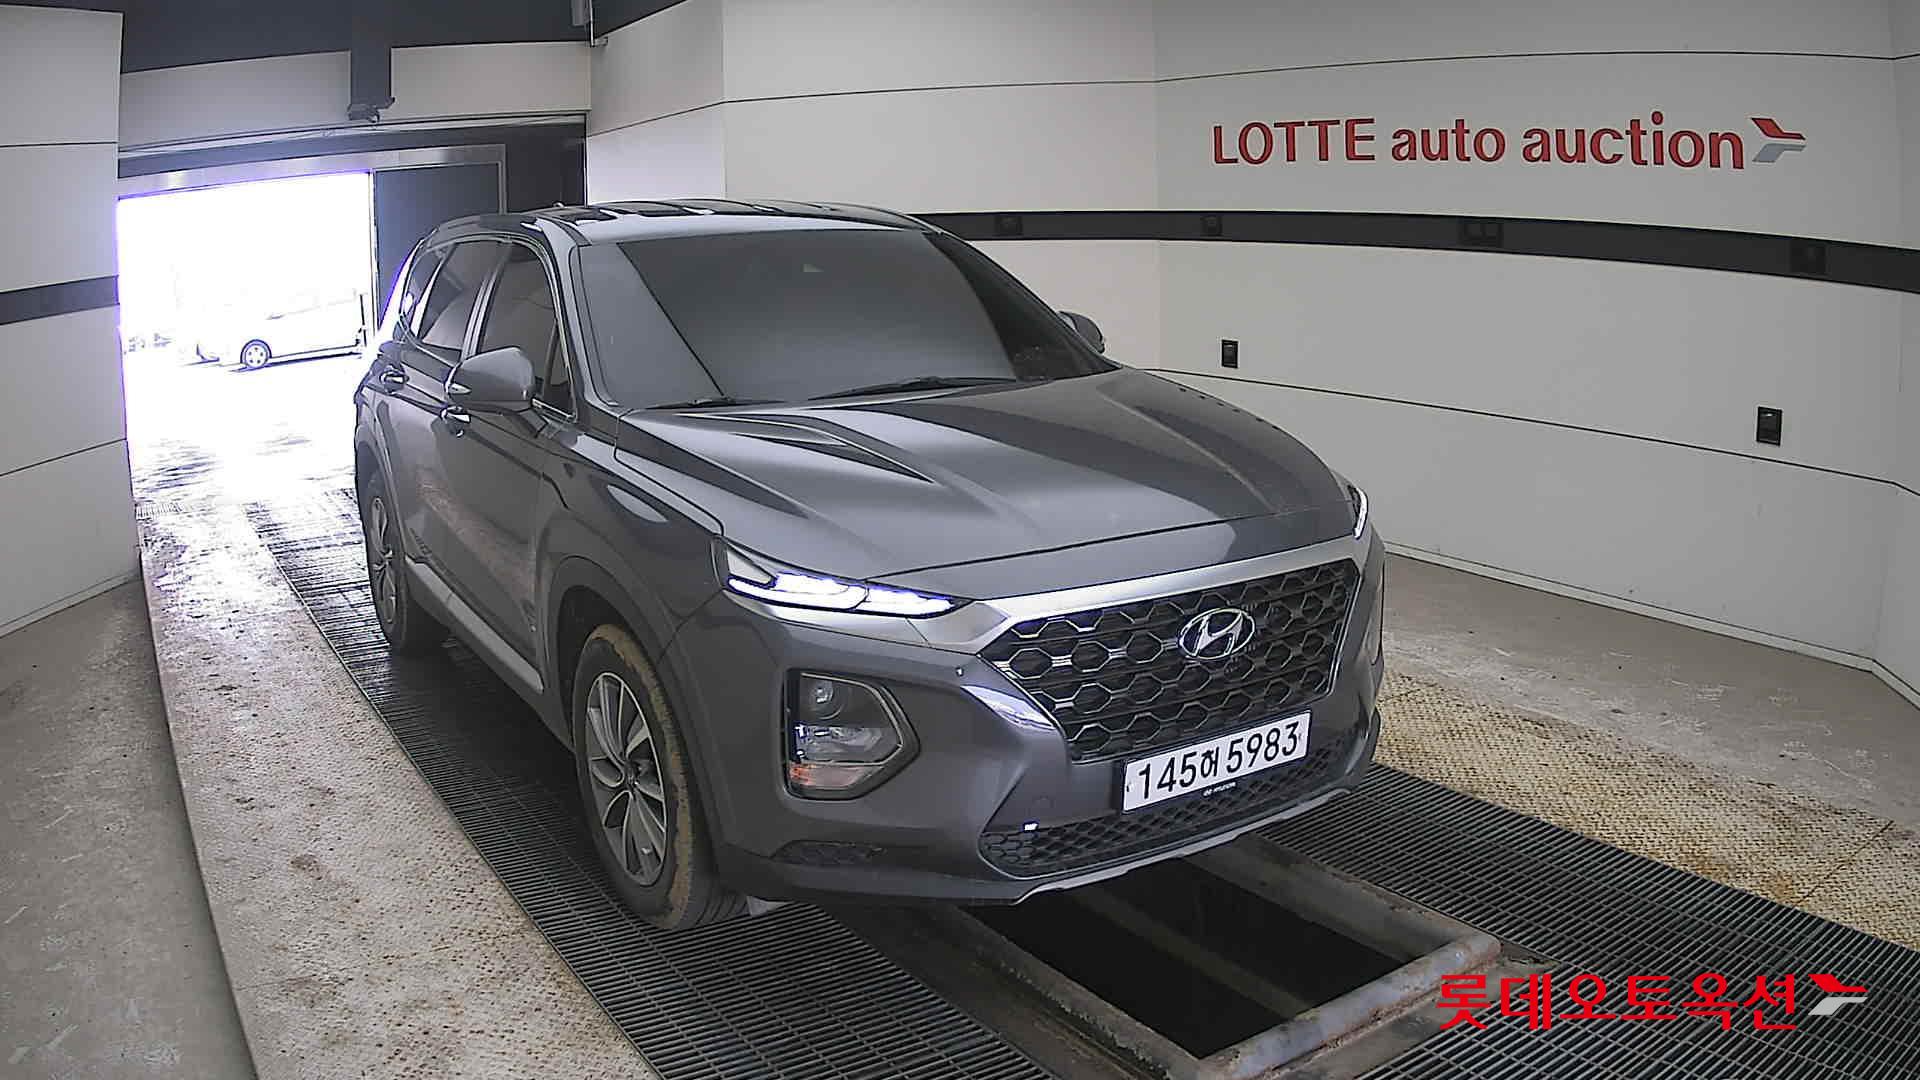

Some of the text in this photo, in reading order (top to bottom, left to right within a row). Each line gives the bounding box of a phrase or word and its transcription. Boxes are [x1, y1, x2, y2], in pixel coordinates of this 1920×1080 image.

[1213, 110, 1744, 170] LOTTE auto auction
